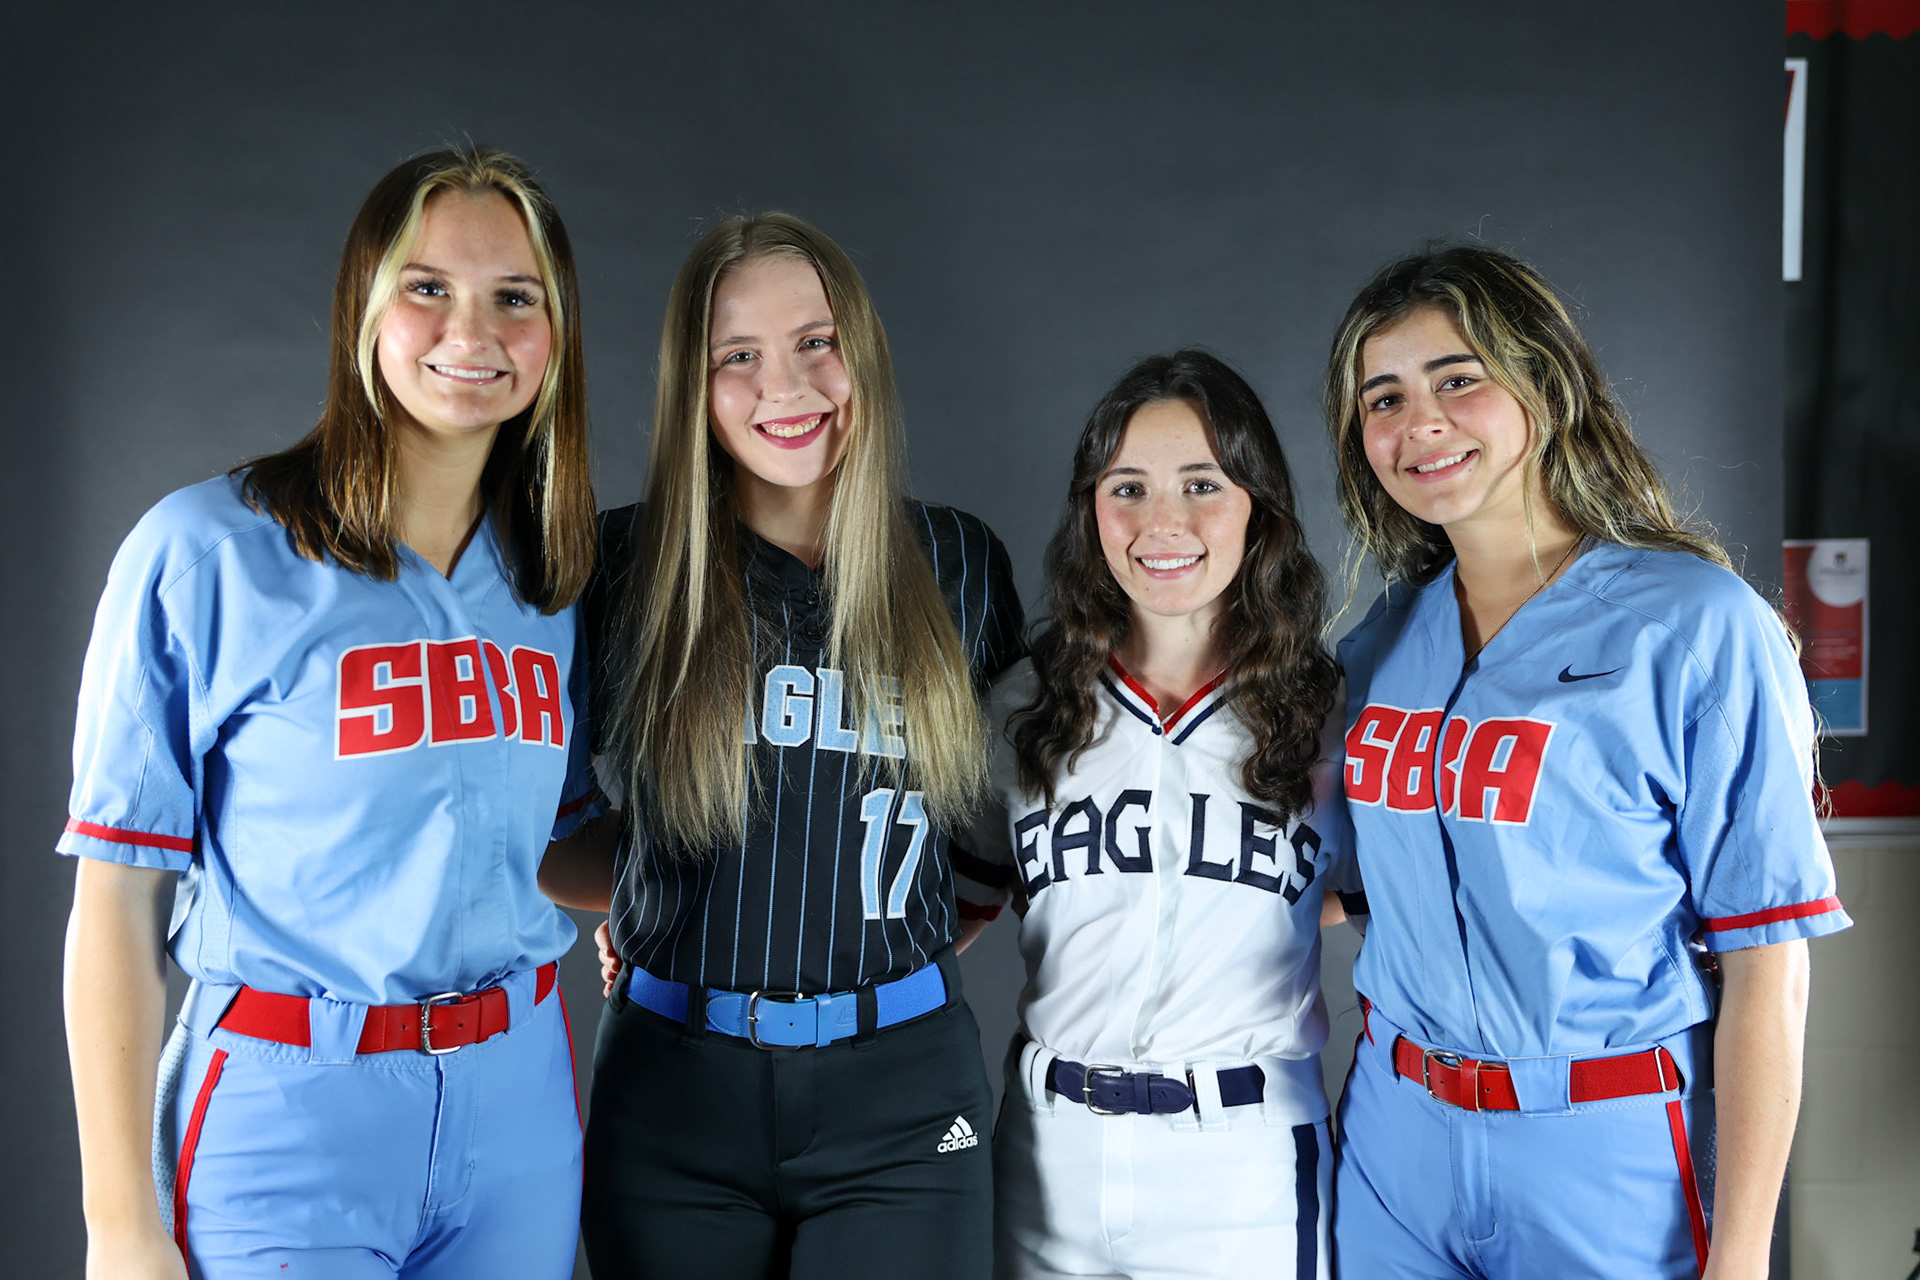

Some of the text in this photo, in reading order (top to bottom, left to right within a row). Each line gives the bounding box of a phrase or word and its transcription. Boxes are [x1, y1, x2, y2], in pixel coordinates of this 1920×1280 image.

[334, 635, 565, 761] SBA
[743, 664, 907, 760] GLE
[1345, 702, 1557, 827] SBA
[859, 787, 930, 920] 17
[1014, 789, 1323, 907] EAGLES
[937, 1134, 979, 1153] adidas
